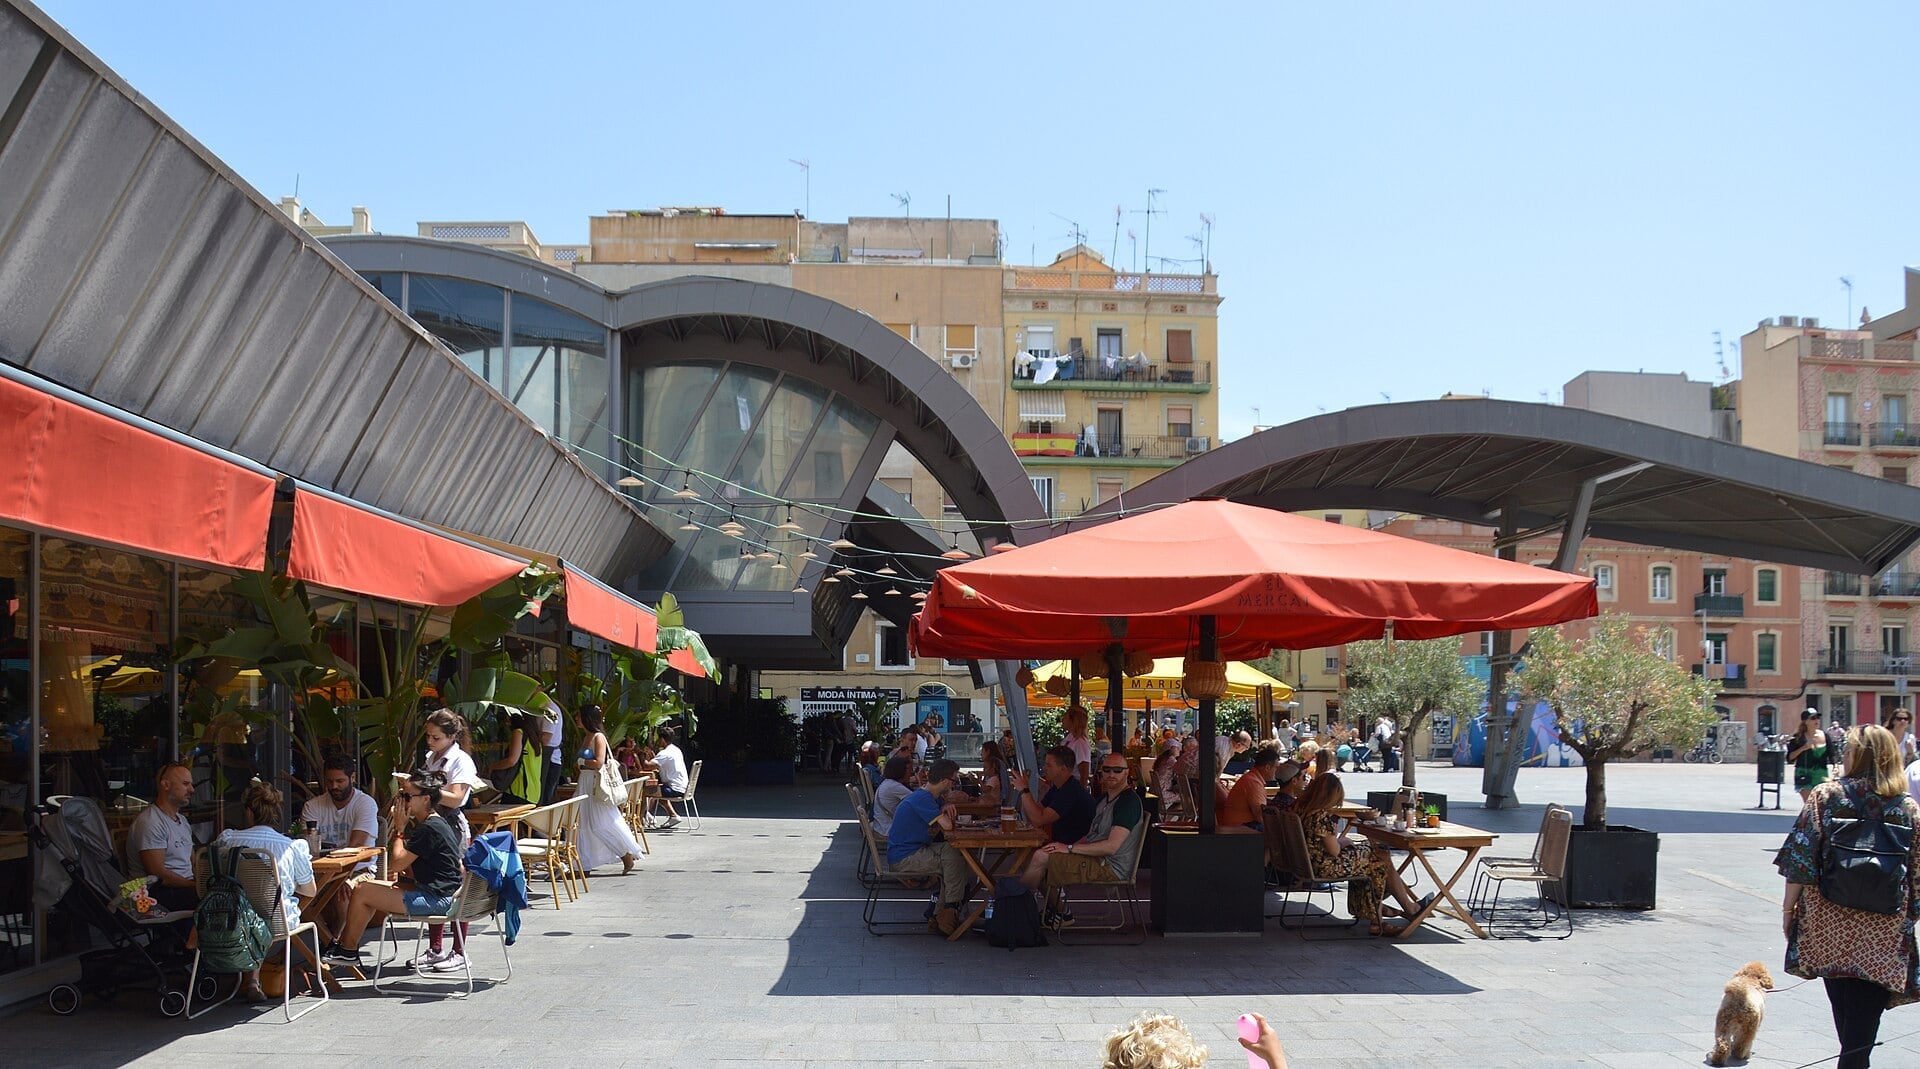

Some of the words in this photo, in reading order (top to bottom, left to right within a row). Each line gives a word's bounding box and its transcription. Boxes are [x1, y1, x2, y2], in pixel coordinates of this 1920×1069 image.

[1264, 575, 1282, 591] EL
[817, 690, 845, 699] MODA
[846, 689, 877, 699] ÍNTIMA
